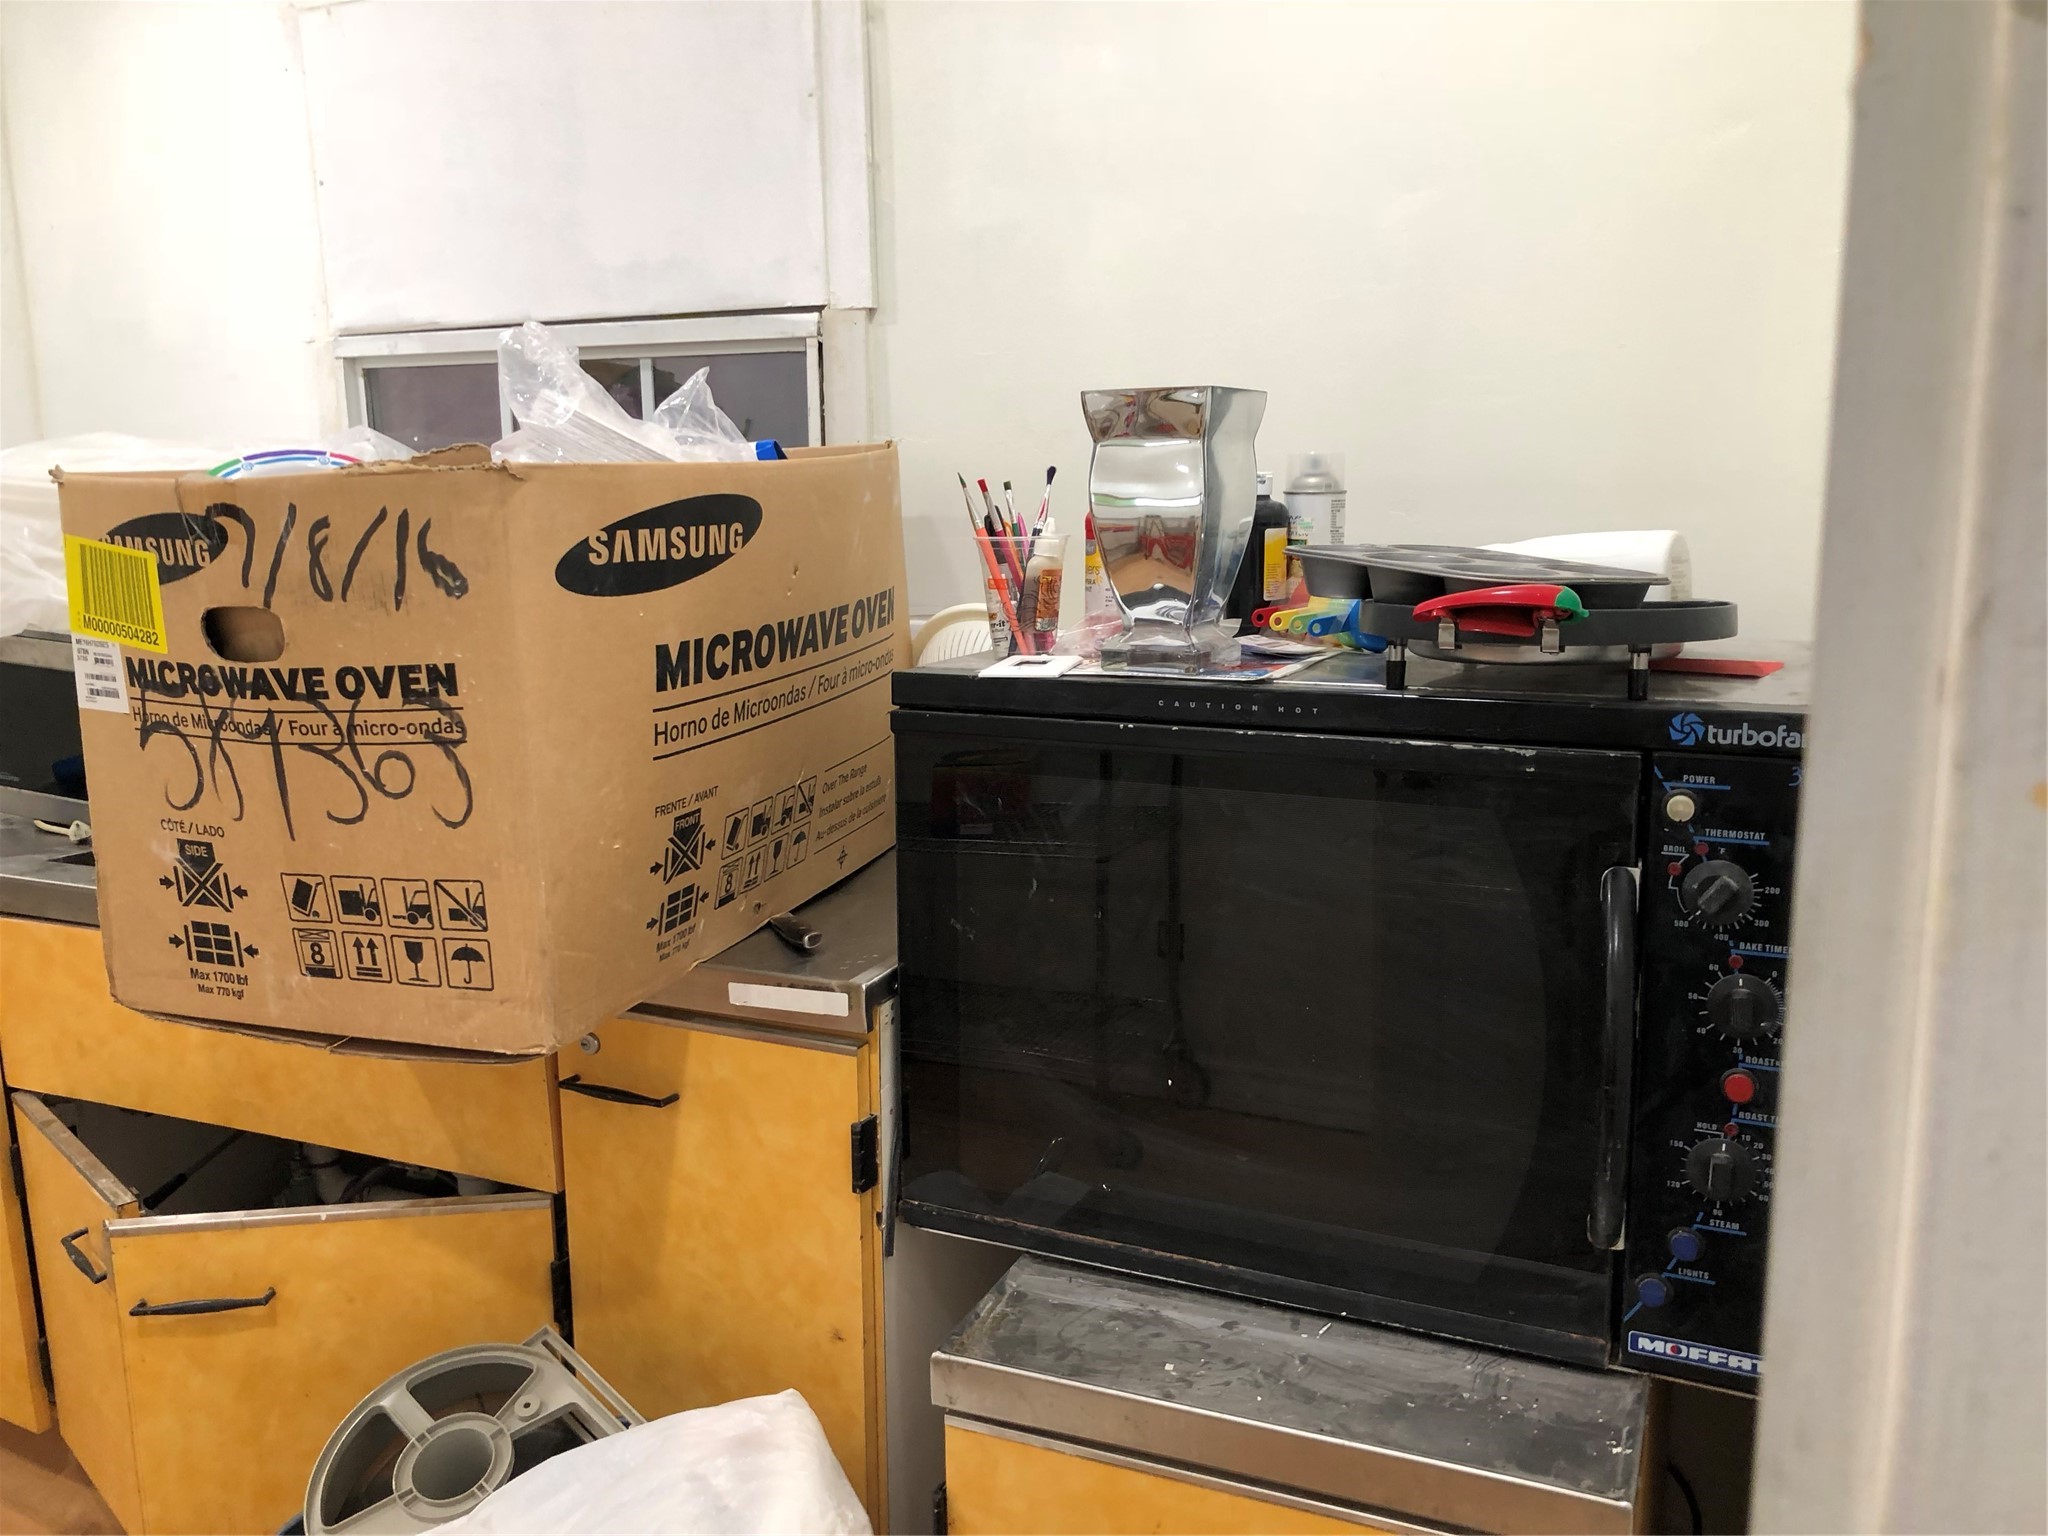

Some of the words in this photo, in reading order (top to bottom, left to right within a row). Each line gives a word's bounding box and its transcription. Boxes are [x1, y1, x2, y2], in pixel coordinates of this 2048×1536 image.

[587, 521, 745, 566] SAMSUNG
[83, 614, 160, 646] M00000504282
[655, 604, 850, 693] MICROWAVE
[851, 585, 895, 639] OVEN
[125, 656, 330, 701] MICROWAVE
[335, 663, 459, 700] OVEN
[653, 715, 708, 747] Horno
[711, 707, 730, 731] de
[733, 677, 807, 724] Microondas
[807, 674, 818, 700] /
[816, 672, 841, 696] Four
[841, 666, 848, 686] à
[1158, 699, 1259, 712] CAUTION
[1277, 706, 1319, 716] HOT
[132, 706, 167, 726] Horno
[173, 709, 188, 728] de
[288, 719, 329, 737] Four
[350, 718, 465, 737] micro-ondas
[822, 780, 837, 795] Over
[837, 772, 849, 786] The
[1682, 774, 1716, 785] POWER
[655, 798, 688, 818] FRENTE
[693, 786, 719, 803] AVANT
[675, 812, 700, 831] FRONT
[160, 818, 187, 835] CÔTÉ
[195, 823, 225, 838] LADO
[1704, 828, 1766, 841] THERMOSTAT
[185, 844, 209, 857] SIDE
[1663, 844, 1687, 853] BROIL
[724, 873, 733, 892] 8
[1764, 886, 1780, 895] 200
[1674, 919, 1689, 928] 500
[1754, 919, 1770, 928] 300
[1713, 933, 1729, 941] 400
[1739, 941, 1762, 952] BAKE
[310, 942, 324, 965] 8
[190, 967, 211, 981] Max
[213, 971, 235, 984] 1700
[1772, 970, 1778, 978] 0
[197, 983, 215, 994] Max
[1688, 992, 1698, 1000] 50
[1738, 1111, 1768, 1122] ROAST
[1696, 1121, 1717, 1131] HOLD
[1669, 1139, 1684, 1148] 150
[1741, 1134, 1751, 1142] 10
[1753, 1142, 1764, 1150] 20
[1761, 1153, 1772, 1161] 30
[1666, 1180, 1681, 1188] 120
[1709, 1218, 1740, 1230] STEAM
[1678, 1266, 1709, 1280] LIGHTS
